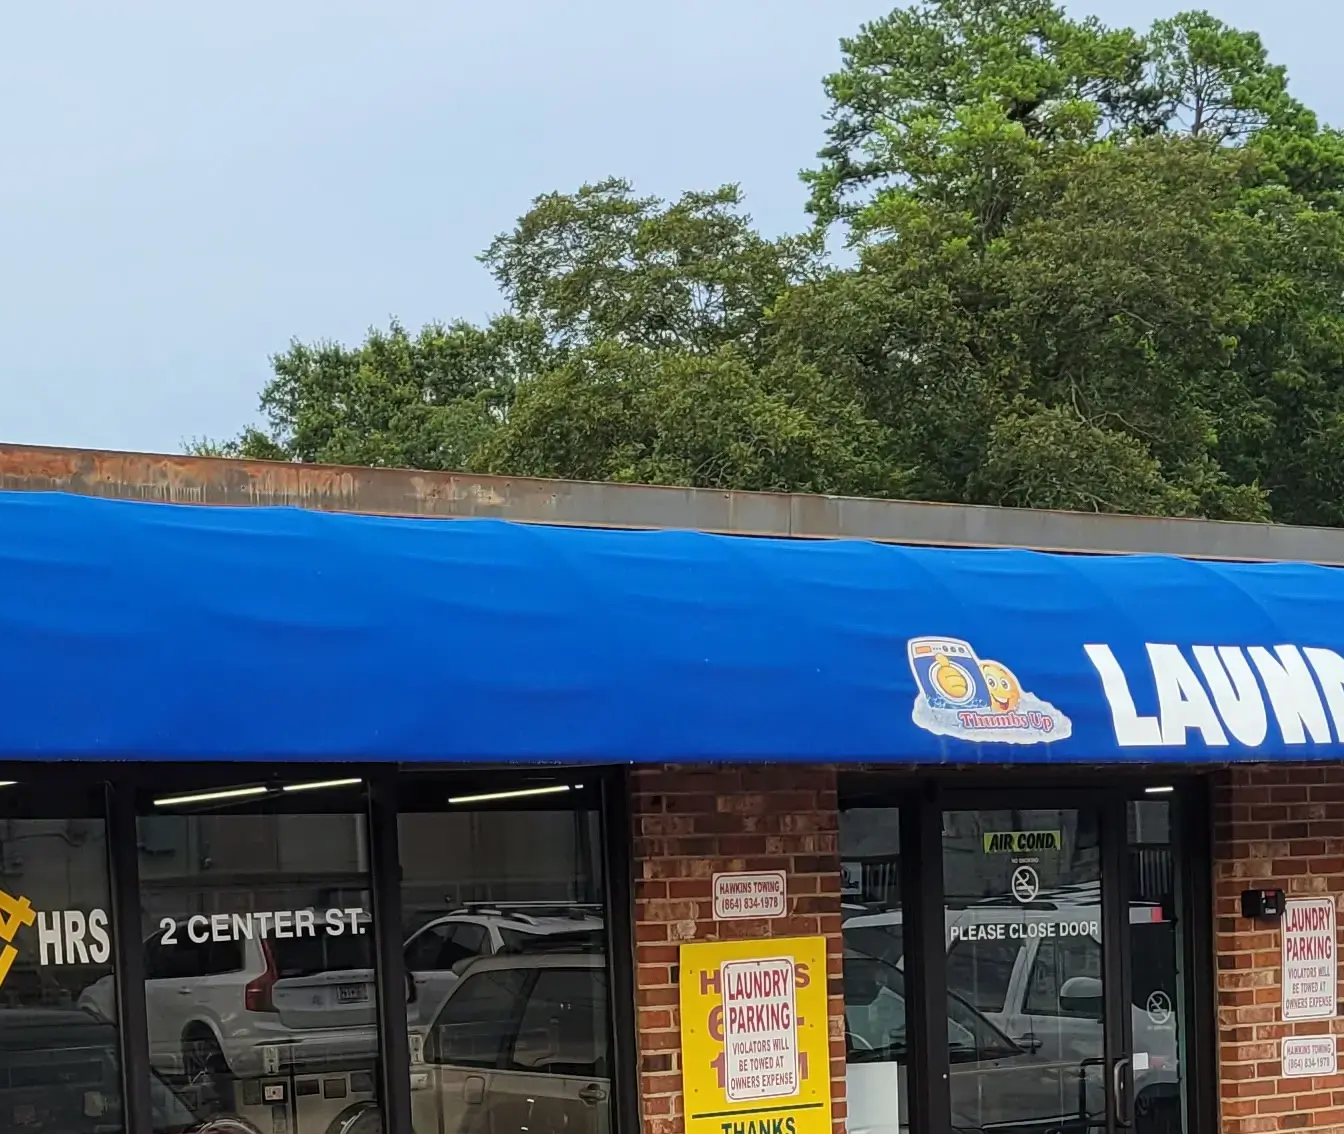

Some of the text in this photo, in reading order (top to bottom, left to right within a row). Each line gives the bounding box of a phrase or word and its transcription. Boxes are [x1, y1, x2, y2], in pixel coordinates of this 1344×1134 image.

[959, 712, 1053, 732] Thumbs Up
[989, 832, 1058, 850] AIR COND.
[720, 880, 779, 894] HAWKINS TOWING
[722, 896, 778, 913] (864) 834-1978
[159, 908, 365, 945] 2 CENTER ST.
[1285, 907, 1331, 933] LAUNDRY
[37, 908, 110, 966] HRS
[950, 921, 1098, 941] PLEASE CLOSE DOOR
[1286, 935, 1332, 962] PARKING
[1288, 965, 1330, 979] VIOLATORS WILL
[728, 969, 789, 1000] LAUNDRY
[1292, 981, 1326, 994] BE TOWED AT
[1286, 996, 1332, 1009] OWNERS EXPENSE
[729, 1002, 790, 1035] PARKING
[732, 1037, 789, 1055] VIOLATORS WILL
[738, 1056, 784, 1072] BE TOWED AT
[730, 1072, 793, 1091] OWNERS EXPENSE
